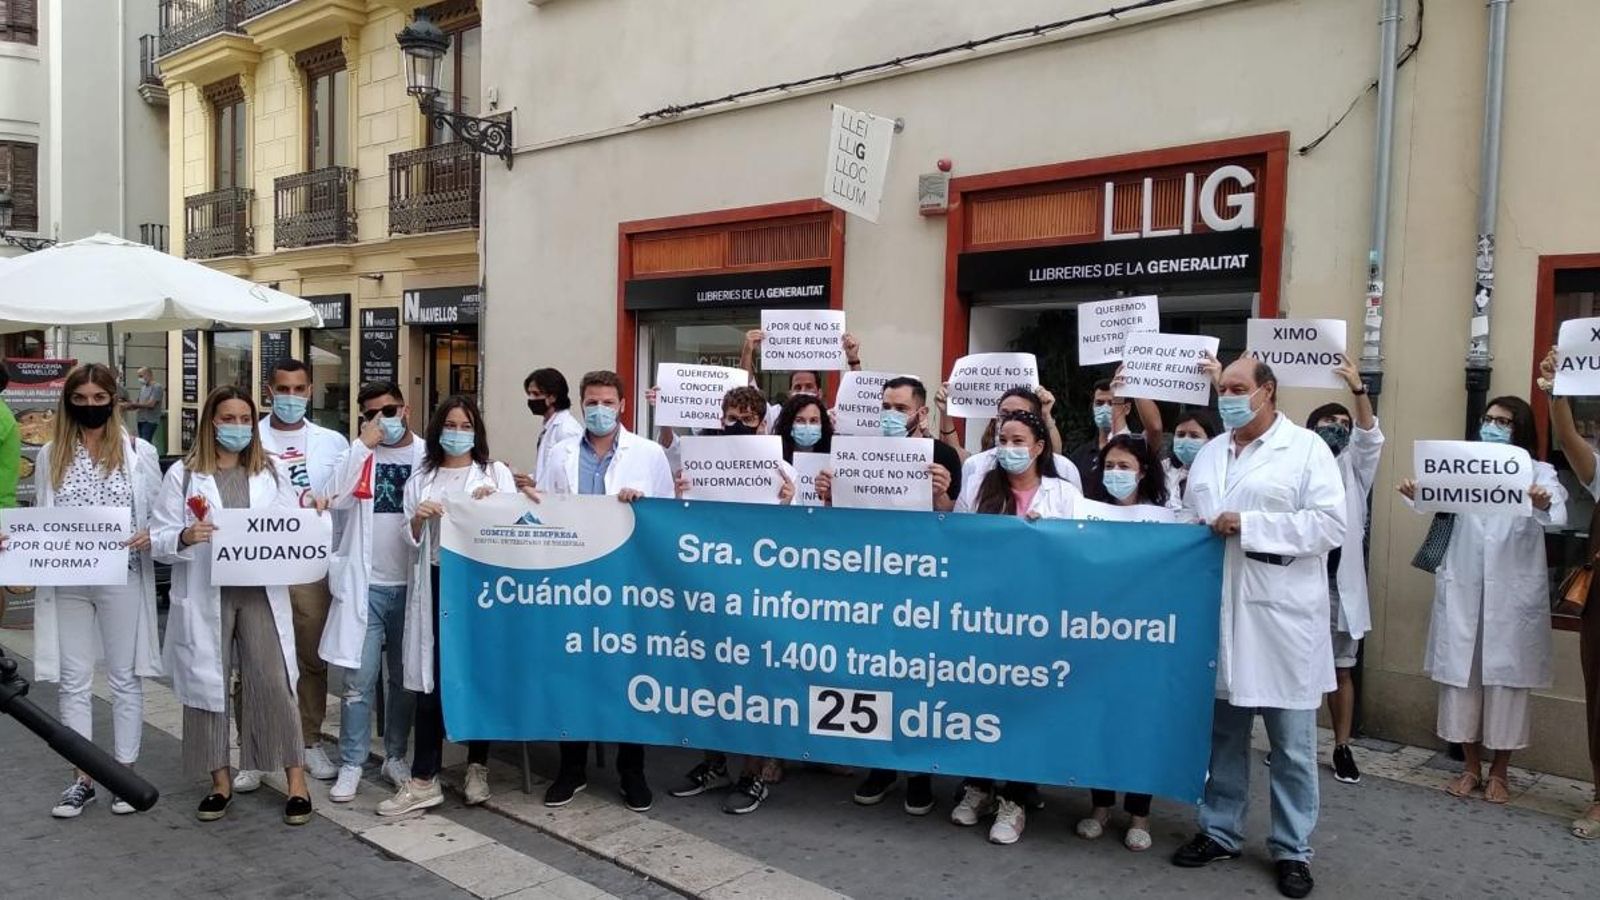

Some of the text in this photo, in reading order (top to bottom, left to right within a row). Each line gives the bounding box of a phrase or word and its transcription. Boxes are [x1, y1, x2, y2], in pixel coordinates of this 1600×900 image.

[842, 112, 868, 139] LLEI
[839, 133, 865, 160] LLIG
[836, 154, 867, 183] LLOC
[833, 176, 866, 206] LLUM
[1104, 165, 1256, 241] LLIG
[1105, 263, 1123, 276] DE
[1127, 262, 1144, 276] LA
[1148, 255, 1248, 274] GENERALITAT
[742, 289, 753, 300] DE
[754, 288, 765, 298] LA
[767, 285, 824, 298] GENERALITAT
[405, 292, 420, 322] N
[420, 306, 458, 322] NAVELLOS
[1096, 302, 1146, 315] QUEREMOS
[366, 311, 374, 326] N
[1100, 316, 1142, 328] CONOCER
[766, 322, 790, 331] ¿POR
[792, 321, 811, 331] QUÉ
[831, 322, 840, 330] SE
[1083, 332, 1124, 344] NUESTRO
[1273, 328, 1317, 340] XIMO
[769, 337, 802, 345] QUIERE
[787, 351, 842, 359] NOSOTROS?
[1128, 346, 1152, 356] ¿POR
[1156, 346, 1176, 356] QUÉ
[1179, 349, 1195, 359] NO
[1198, 350, 1209, 359] SE
[1252, 352, 1341, 366] AYUDANOS
[954, 366, 1034, 376] ¿POR QUÉ NO SE
[1127, 361, 1204, 374] QUIERE REUNIR
[676, 369, 729, 379] QUEREMOS
[680, 382, 724, 392] CONOCER
[955, 382, 990, 391] QUIERE
[1142, 378, 1206, 392] NOSOTROS?
[660, 395, 722, 406] NUESTRO FUT
[858, 391, 883, 400] CONO
[952, 397, 972, 405] CON
[838, 404, 879, 414] NUESTRO
[680, 411, 720, 420] LABORAL
[856, 419, 880, 428] LABO
[836, 451, 926, 462] SRA. CONSELLERA
[684, 460, 779, 471] SOLO QUEREMOS
[1424, 457, 1519, 474] BARCELÓ
[834, 468, 929, 479] ¿POR QUÉ NO NOS
[692, 474, 772, 486] INFORMACIÓN
[854, 485, 908, 495] INFORMA?
[1421, 486, 1523, 504] DIMISIÓN
[10, 522, 122, 533] SRA. CONSELLERA
[247, 517, 300, 532] XIMO
[480, 528, 515, 537] COMITÉ
[533, 530, 578, 538] EMPRESA
[6, 538, 125, 552] ¿POR QUÉ NO NOS
[216, 545, 327, 561] AYUDANOS
[678, 534, 948, 578] Sra. Consellera:
[29, 557, 99, 568] INFORMA?
[477, 575, 1176, 643] ¿Cuándo nos va a informar del futuro laboral
[565, 627, 1071, 688] a los más de 1.400 trabajadores?
[628, 674, 1001, 743] Quedan 25 días
